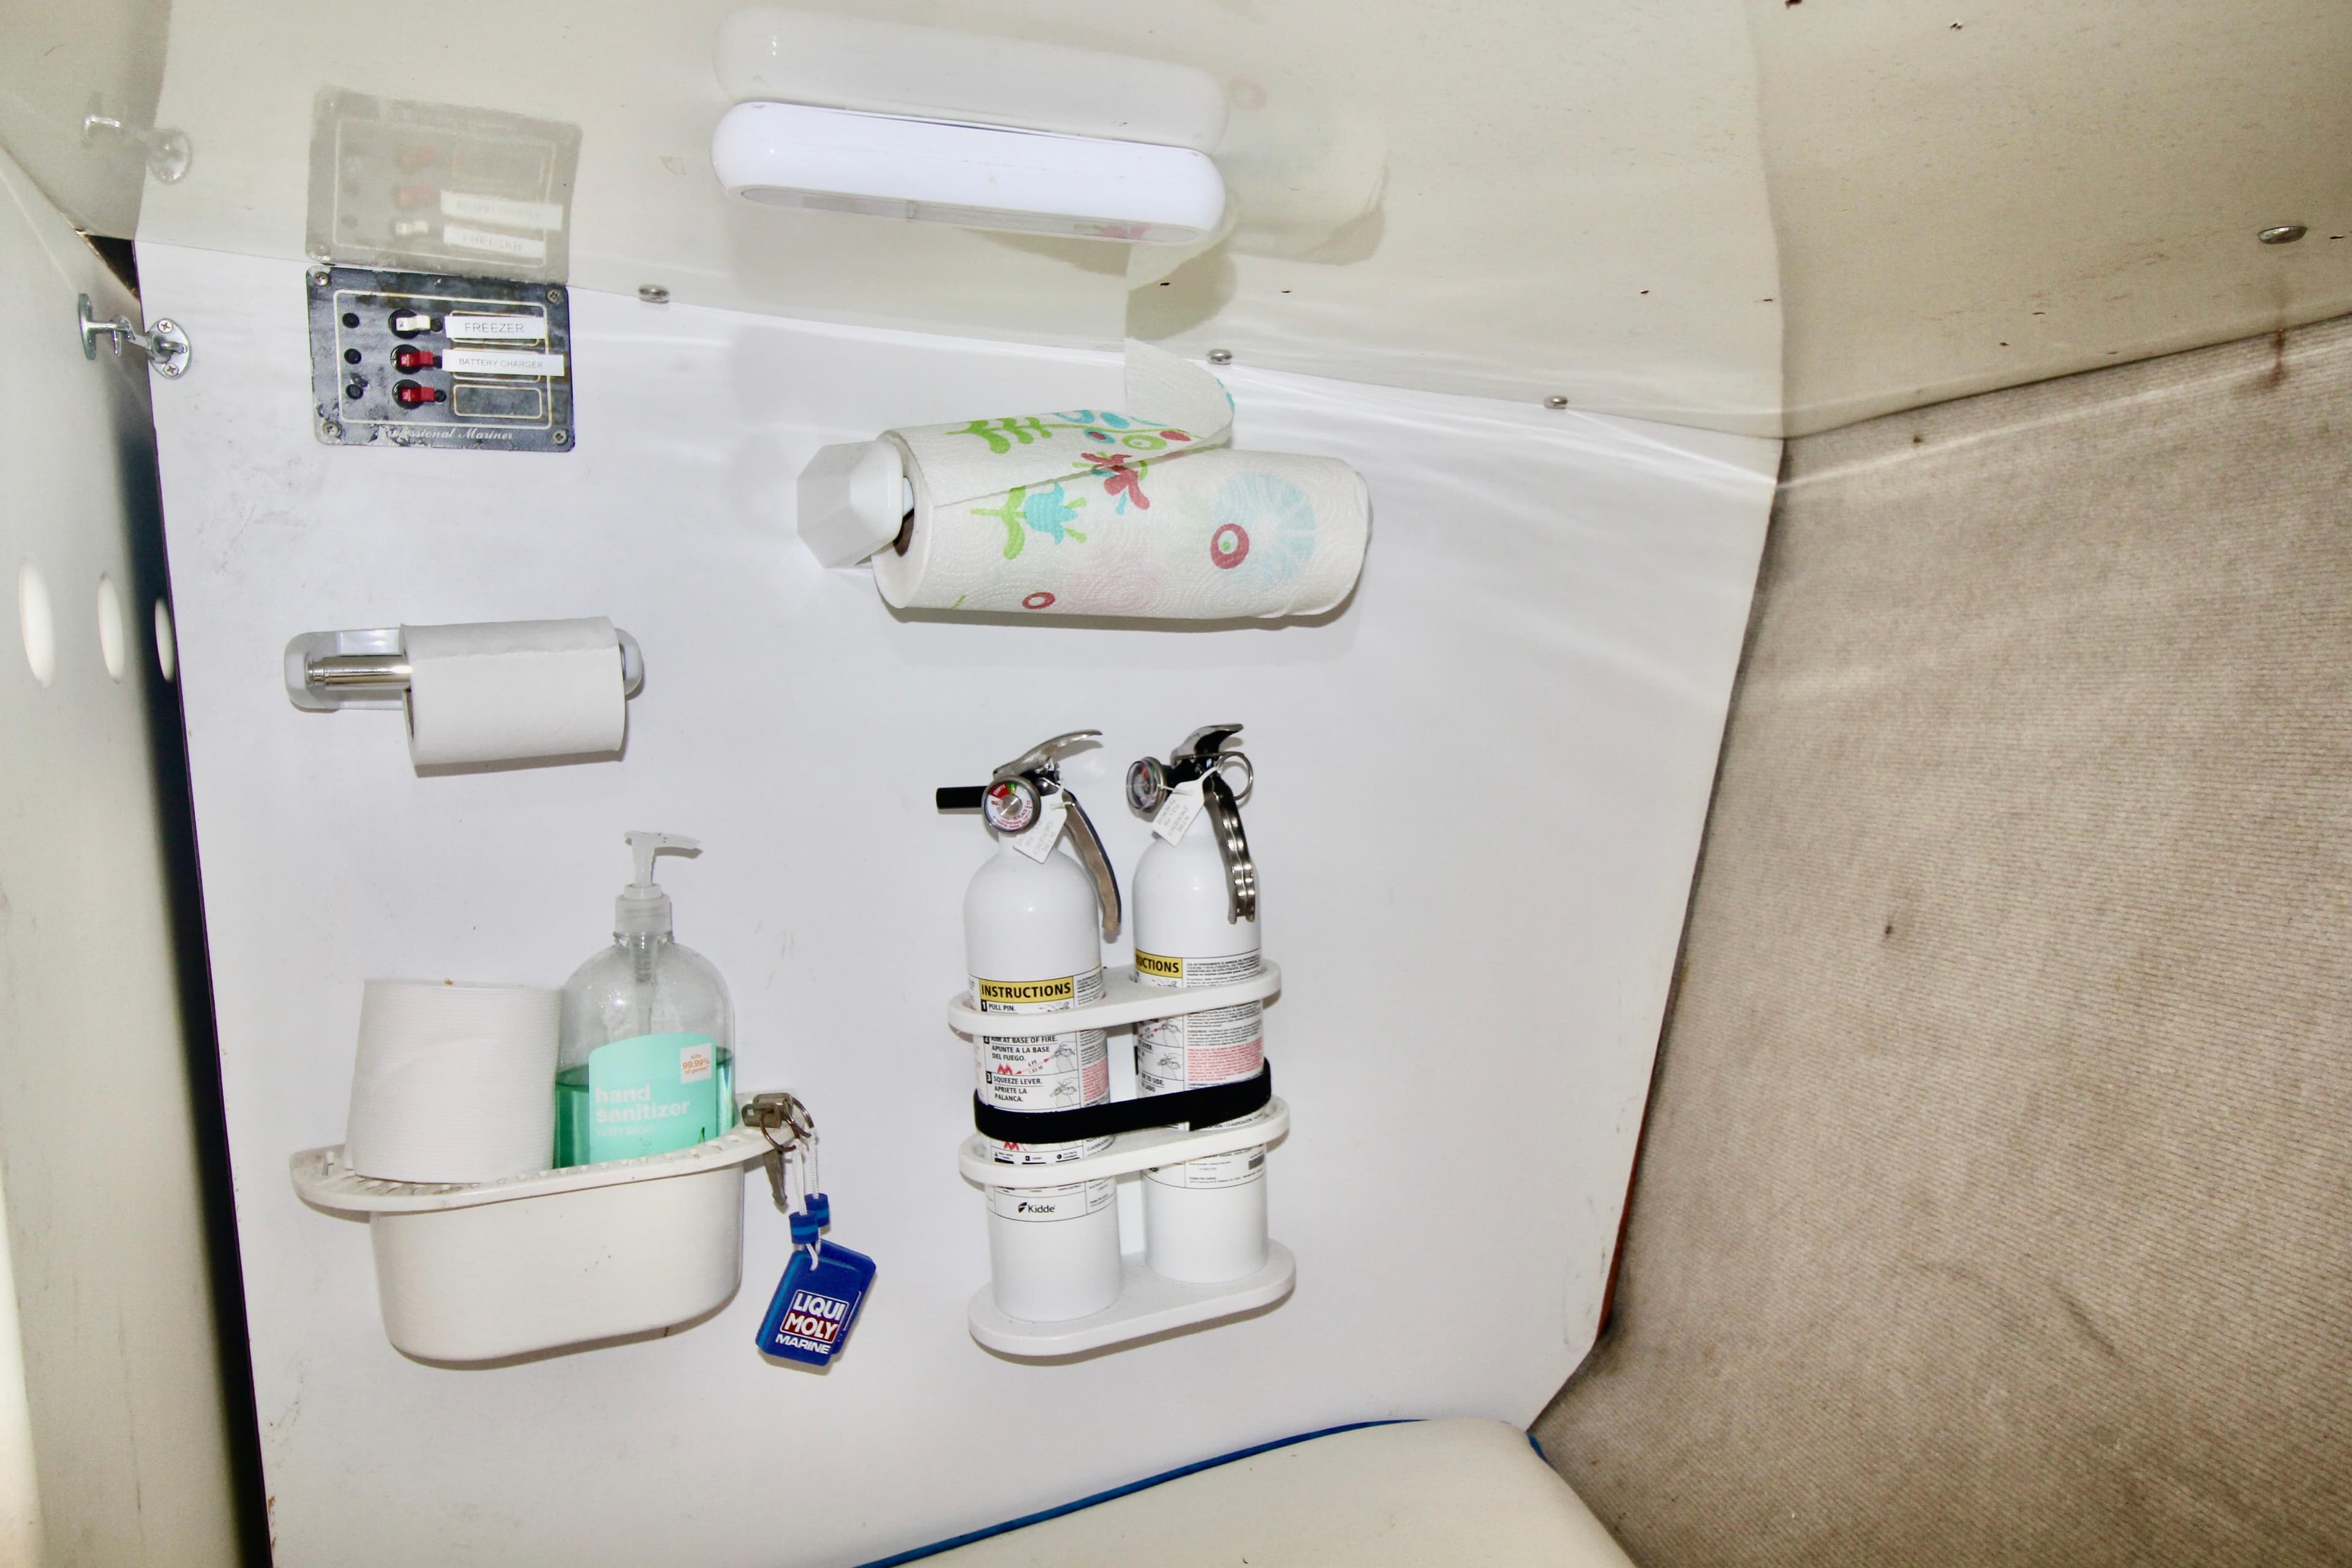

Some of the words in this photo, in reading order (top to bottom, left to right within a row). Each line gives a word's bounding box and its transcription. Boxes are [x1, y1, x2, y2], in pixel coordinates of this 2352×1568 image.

[464, 322, 524, 333] FREEZER
[459, 358, 497, 367] BATTERY
[500, 360, 543, 369] CHARGER
[459, 428, 513, 440] Mariner
[981, 982, 1071, 998] INSTRUCTIONS
[682, 1058, 710, 1069] 99.99%
[993, 1076, 1018, 1084] SQUEEZE
[596, 1084, 651, 1103] hand
[995, 1093, 1023, 1102] PALANCA.
[596, 1101, 691, 1123] sanitizer
[1028, 1205, 1055, 1213] Kidde
[793, 1292, 846, 1321] LIQUI
[784, 1313, 839, 1340] MOLY
[775, 1333, 831, 1355] MARINE
